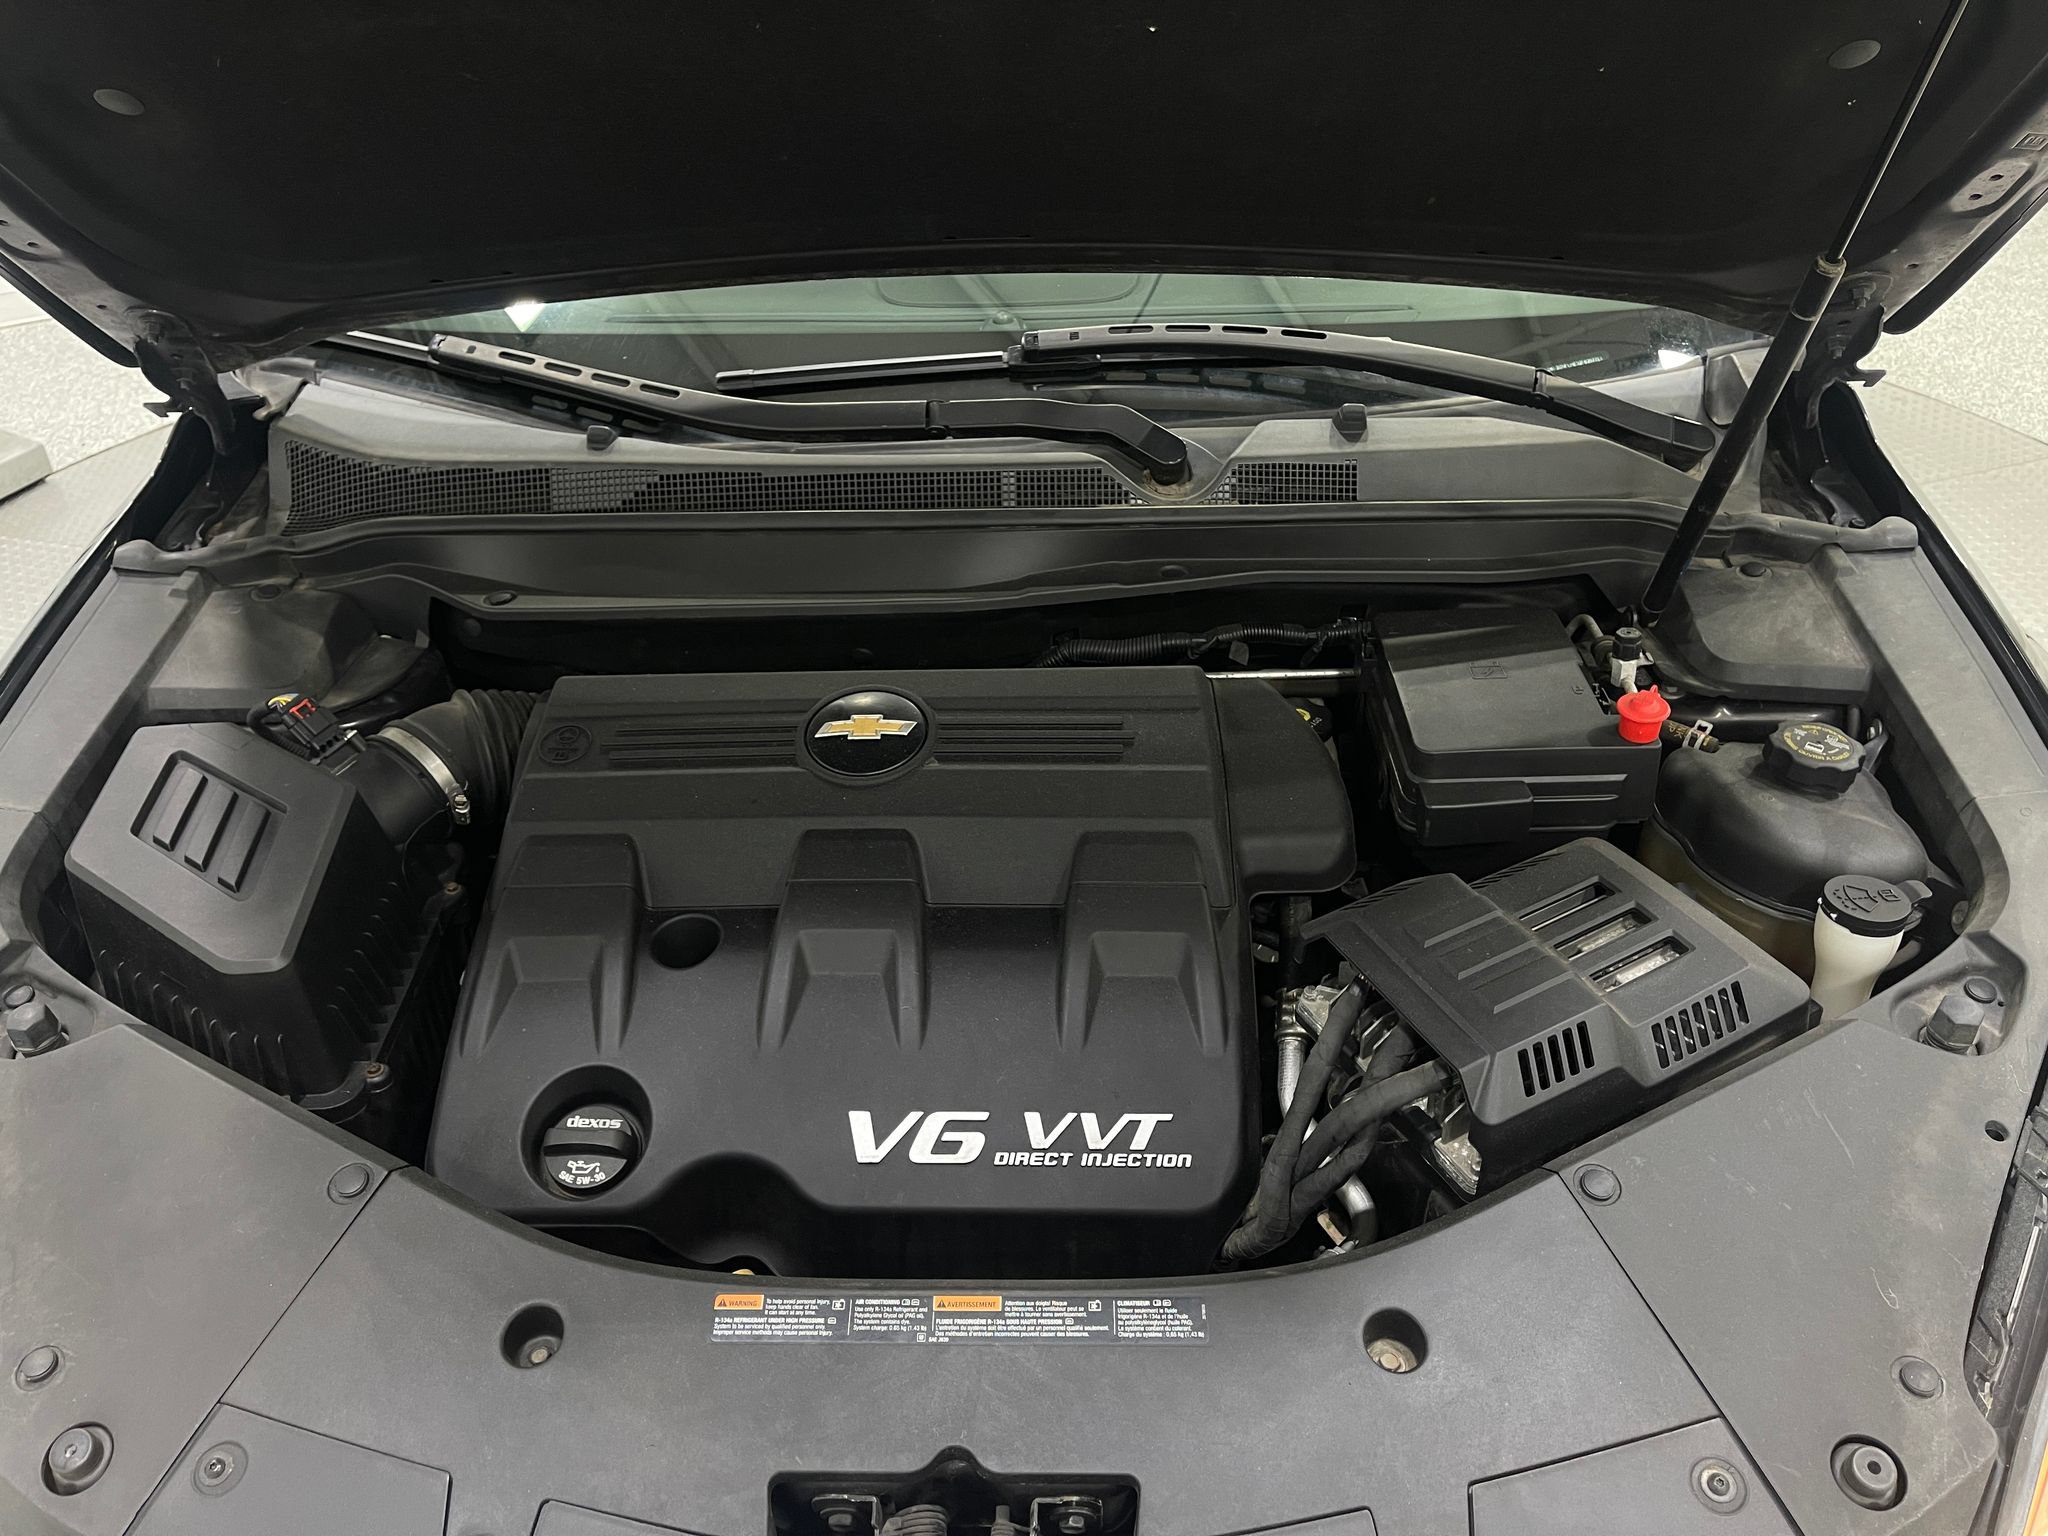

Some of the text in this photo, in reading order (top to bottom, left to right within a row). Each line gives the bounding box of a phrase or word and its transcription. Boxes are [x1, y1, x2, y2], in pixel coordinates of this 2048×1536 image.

[566, 1115, 623, 1128] dexos
[849, 1110, 1174, 1164] V6 VVT
[994, 1152, 1192, 1168] DIRECT INJECTION
[558, 1170, 606, 1185] SAE 5W-30
